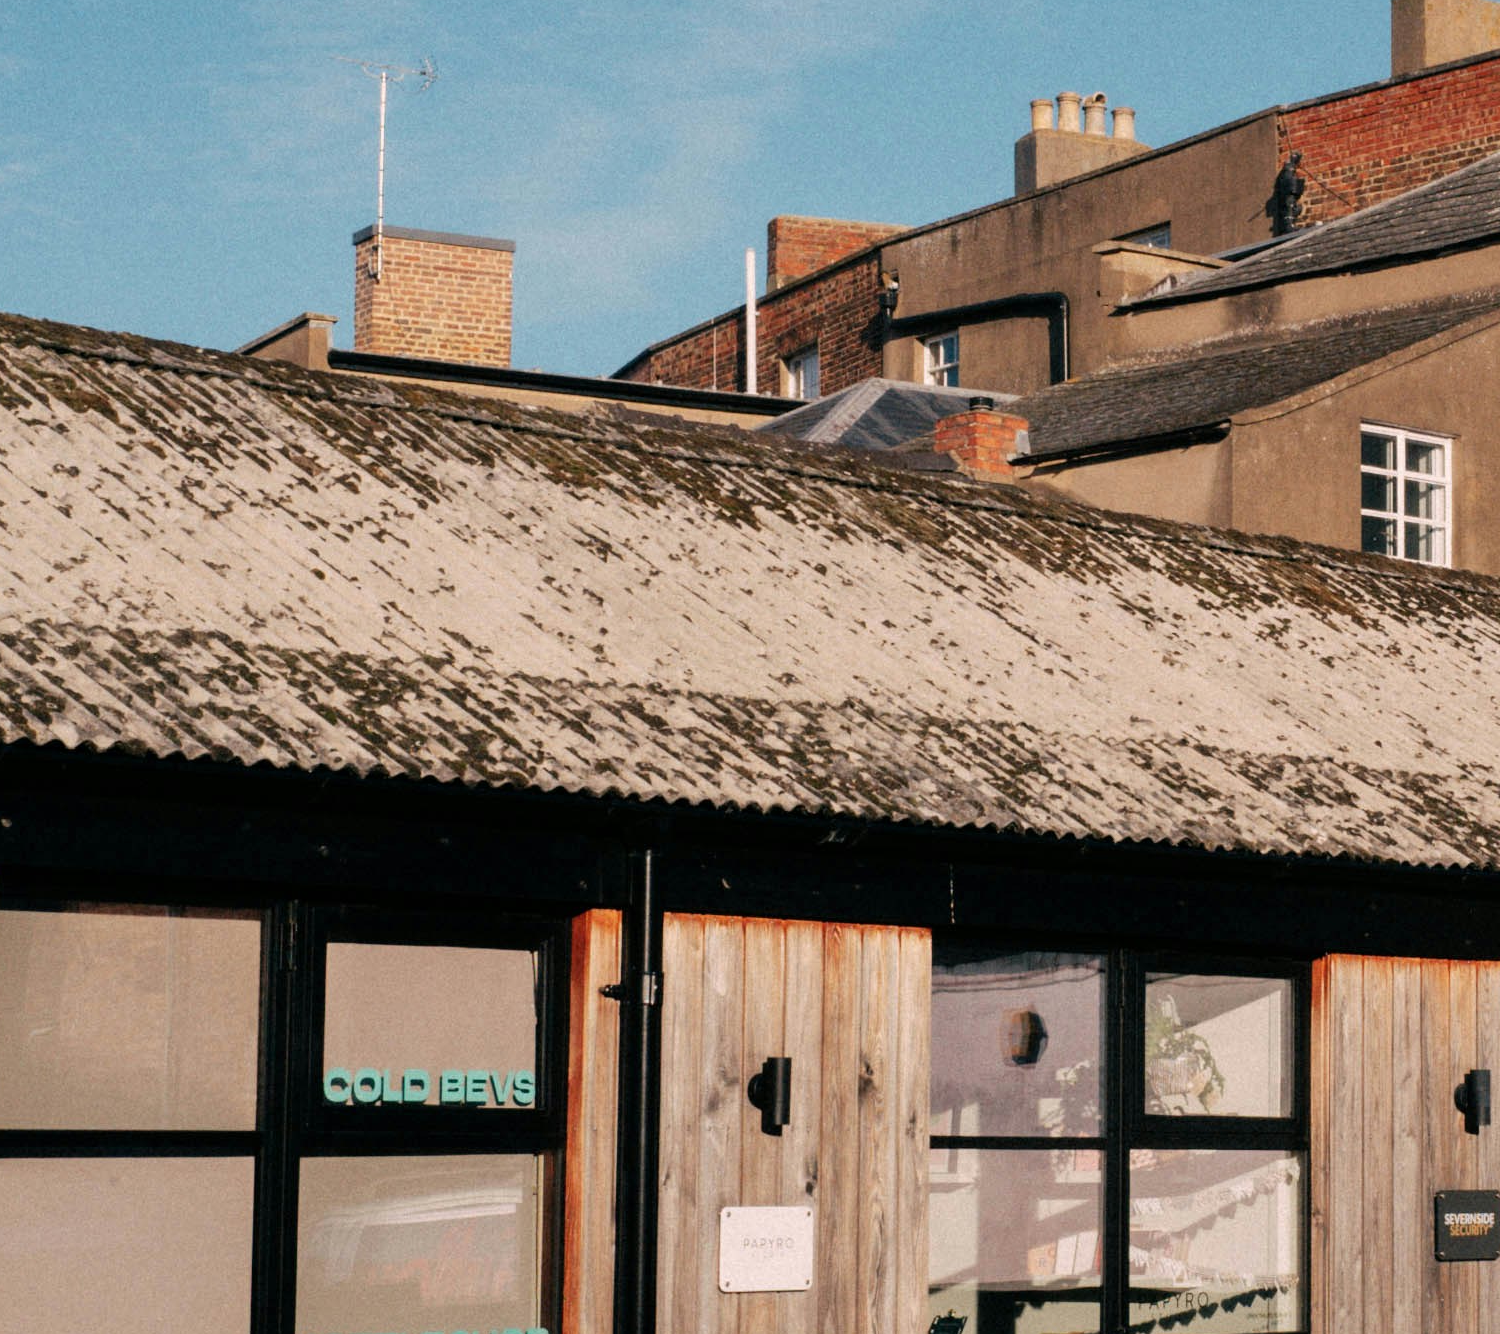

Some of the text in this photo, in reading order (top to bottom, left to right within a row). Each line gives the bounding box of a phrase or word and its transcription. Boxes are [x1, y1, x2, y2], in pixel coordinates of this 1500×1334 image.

[323, 1066, 536, 1106] COLD BEVS
[1444, 1212, 1495, 1225] SEVERNSIDE
[1450, 1224, 1489, 1236] SECURITY
[742, 1237, 794, 1250] PAPYRO
